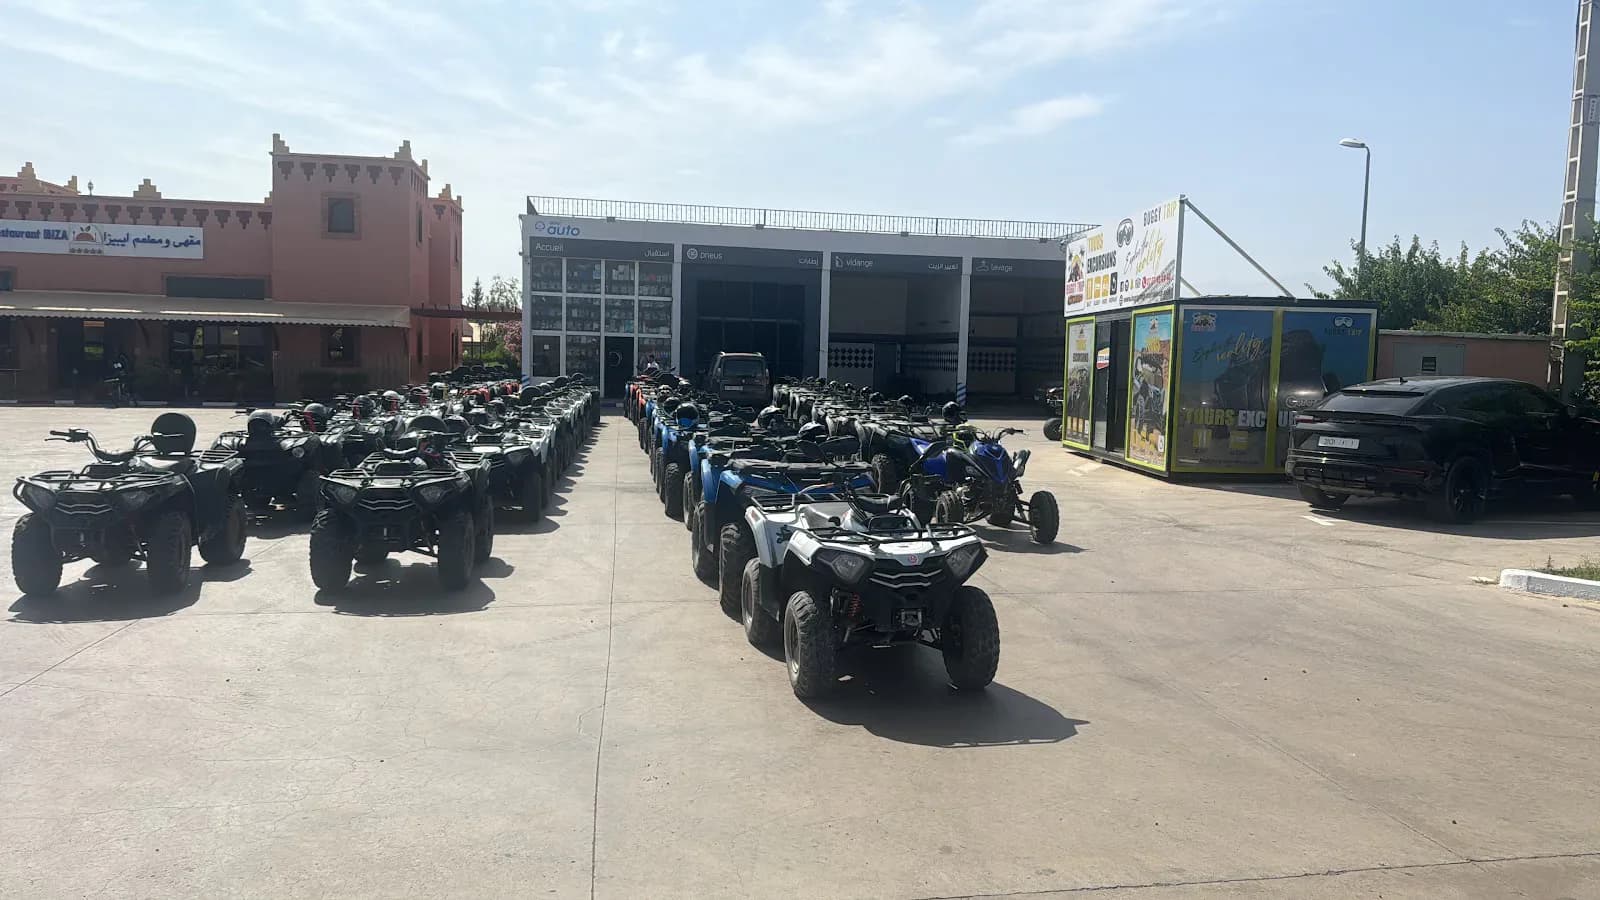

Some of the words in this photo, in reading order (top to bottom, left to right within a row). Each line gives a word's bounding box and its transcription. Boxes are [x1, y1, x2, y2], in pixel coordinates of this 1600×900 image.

[0, 228, 40, 239] staurant
[43, 229, 69, 240] IBIZA
[547, 224, 580, 236] auto
[535, 242, 565, 252] Accueil
[846, 257, 873, 268] vidange
